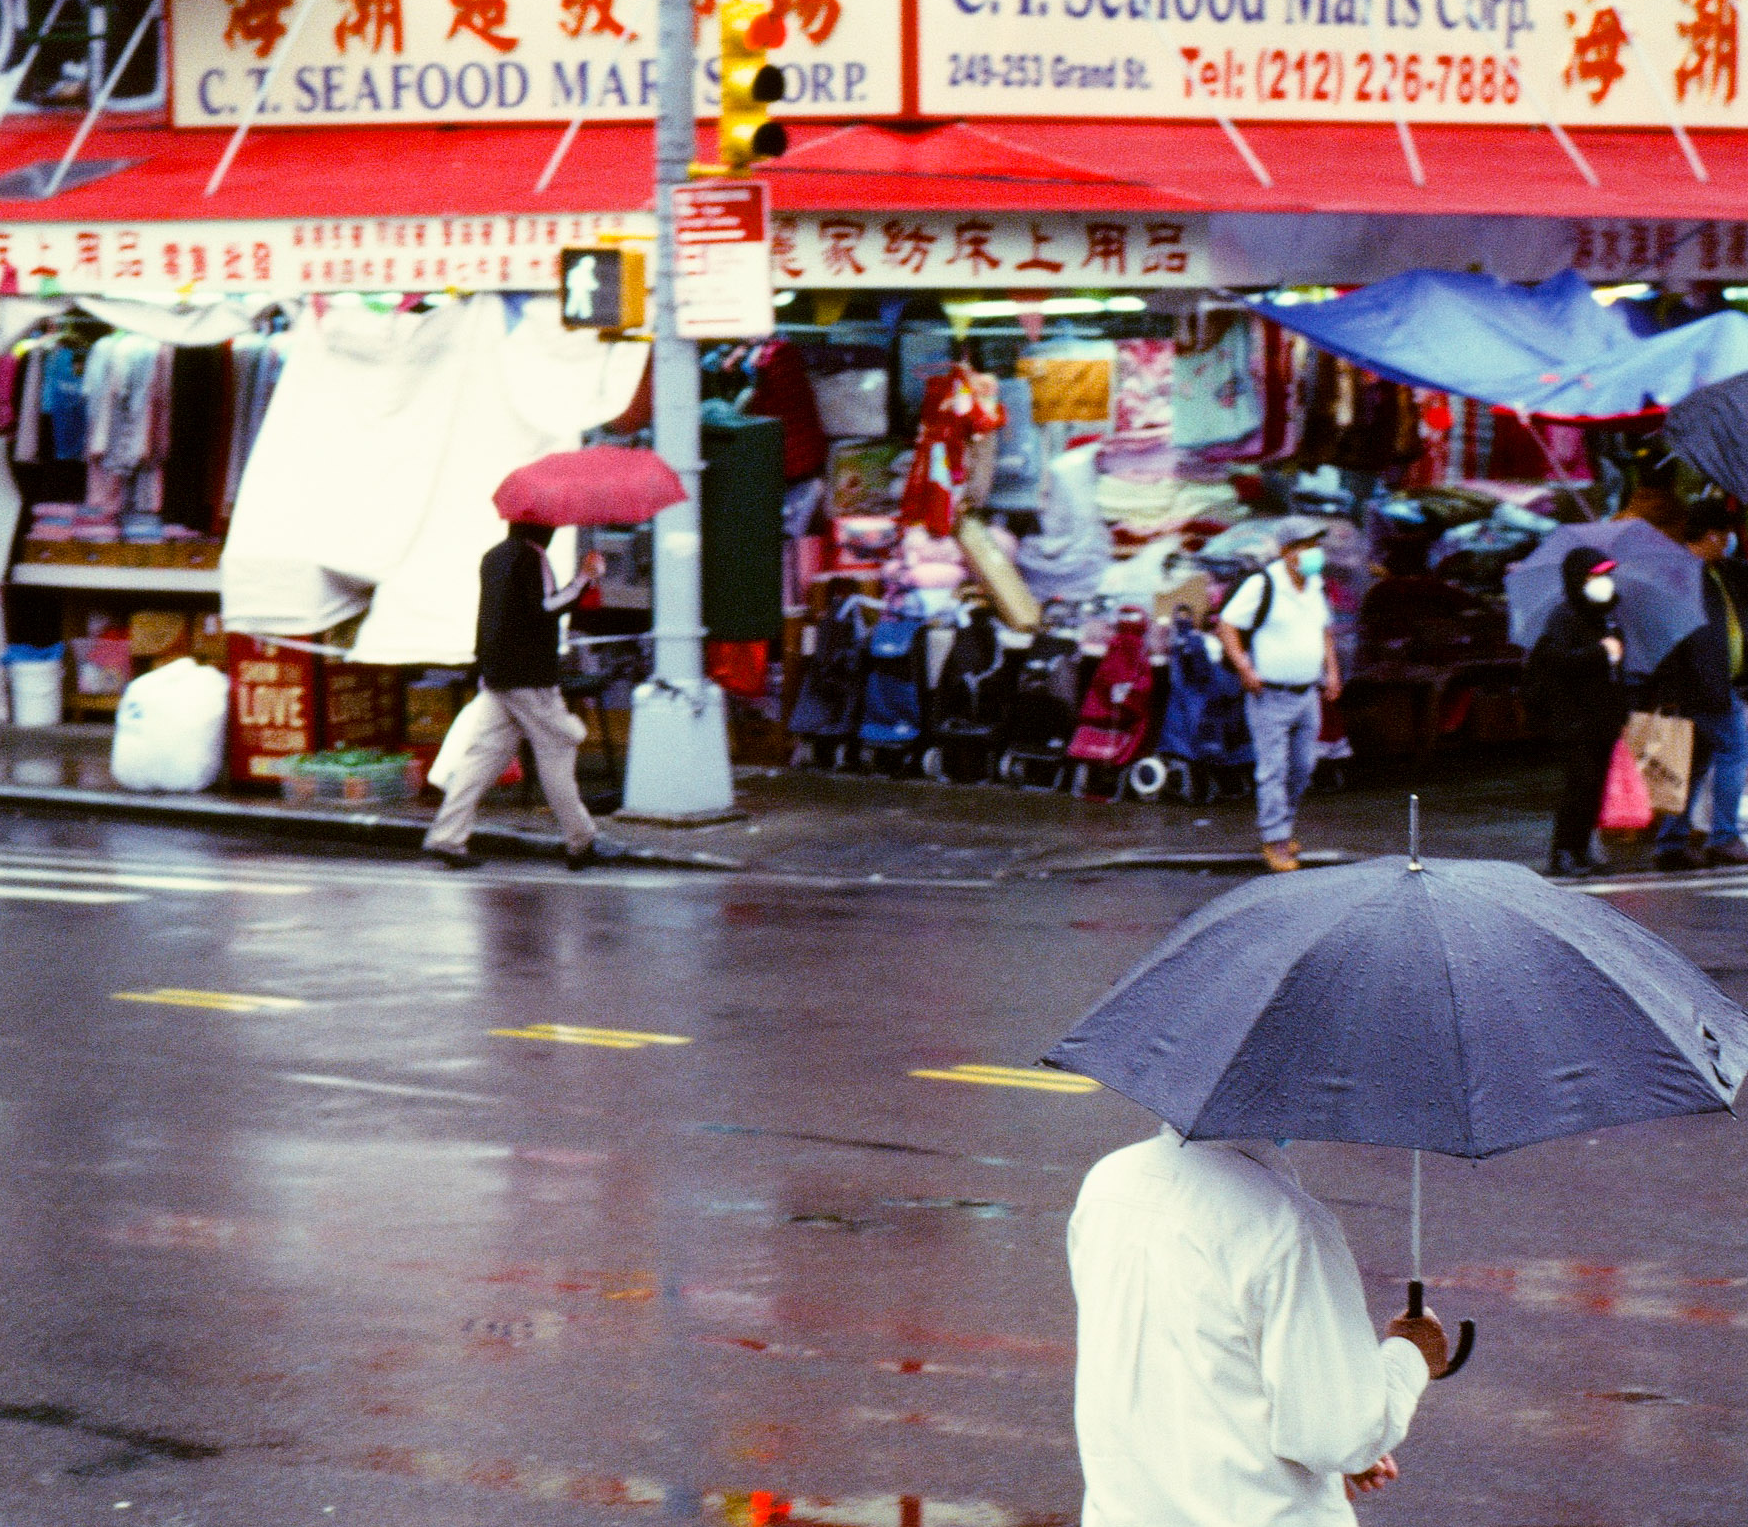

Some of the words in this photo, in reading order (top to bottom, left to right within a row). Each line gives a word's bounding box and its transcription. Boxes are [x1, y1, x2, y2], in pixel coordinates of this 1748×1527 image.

[294, 60, 530, 115] SEAFOOD
[550, 57, 722, 107] MARS
[778, 61, 868, 104] ORP.
[947, 53, 1044, 88] 249-253
[1051, 54, 1118, 90] Grand
[1123, 56, 1153, 91] St.
[1180, 46, 1244, 98] Tel:
[1255, 48, 1346, 105] (212)
[1354, 52, 1522, 106] 226-7888
[238, 685, 305, 727] LOVE
